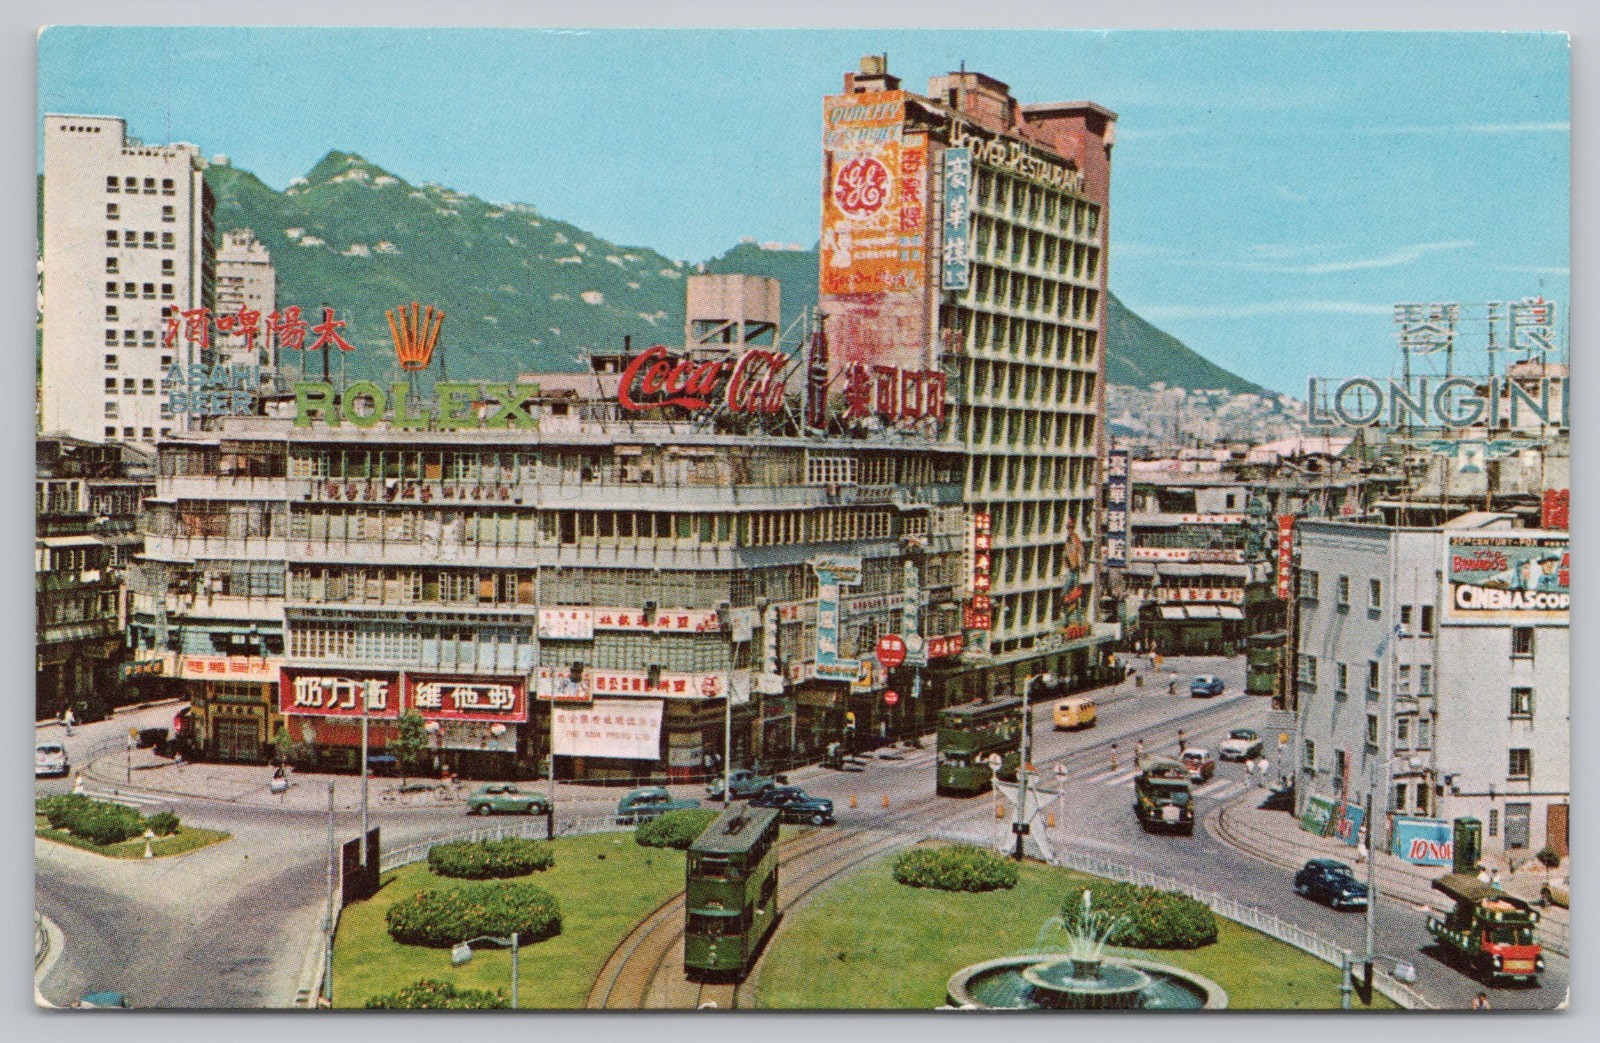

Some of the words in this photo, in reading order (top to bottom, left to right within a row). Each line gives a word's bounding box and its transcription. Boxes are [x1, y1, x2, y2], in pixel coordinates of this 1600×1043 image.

[166, 362, 261, 388] ASAHI
[168, 390, 252, 416] BEER
[293, 381, 541, 428] ROLEX
[1410, 840, 1428, 859] 10
